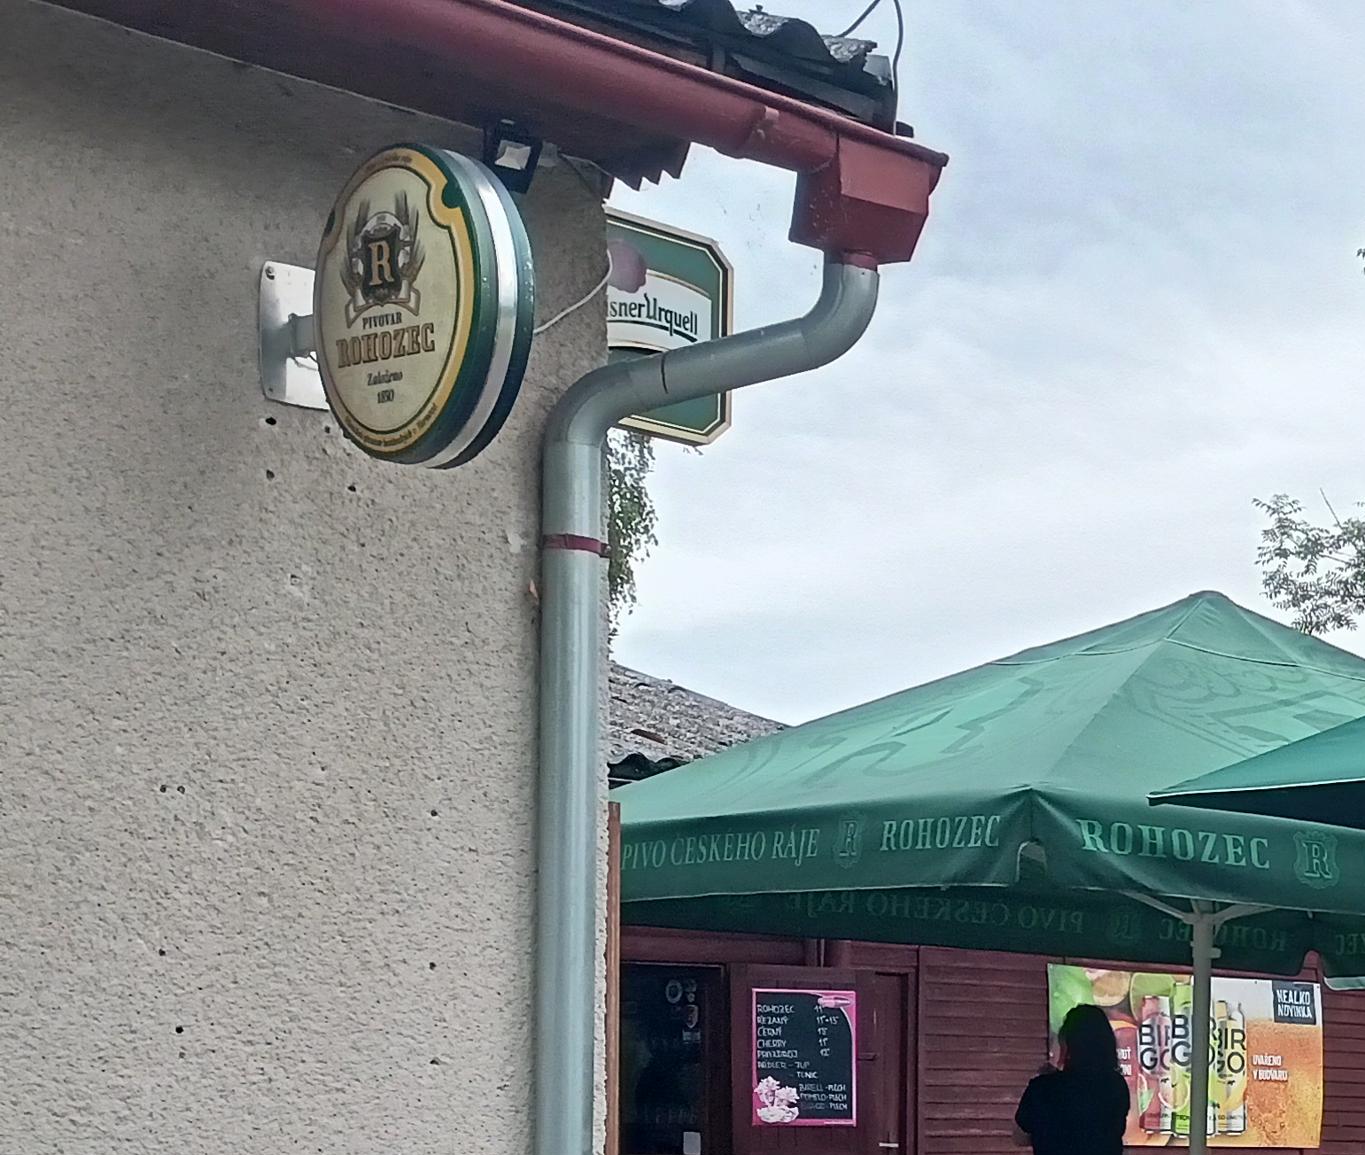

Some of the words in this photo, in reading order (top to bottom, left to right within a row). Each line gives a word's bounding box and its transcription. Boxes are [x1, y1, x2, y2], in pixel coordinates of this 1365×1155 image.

[368, 240, 395, 285] R
[362, 311, 402, 330] PIVOVAR
[609, 300, 645, 318] sner
[643, 293, 698, 336] Urquell
[336, 322, 436, 368] ROHOZEC
[621, 839, 666, 872] PIVO
[772, 824, 820, 866] RÁJE
[880, 815, 1001, 852] ROHOZEC
[1076, 819, 1270, 869] ROHOZEC
[1276, 989, 1310, 1005] NEALKO
